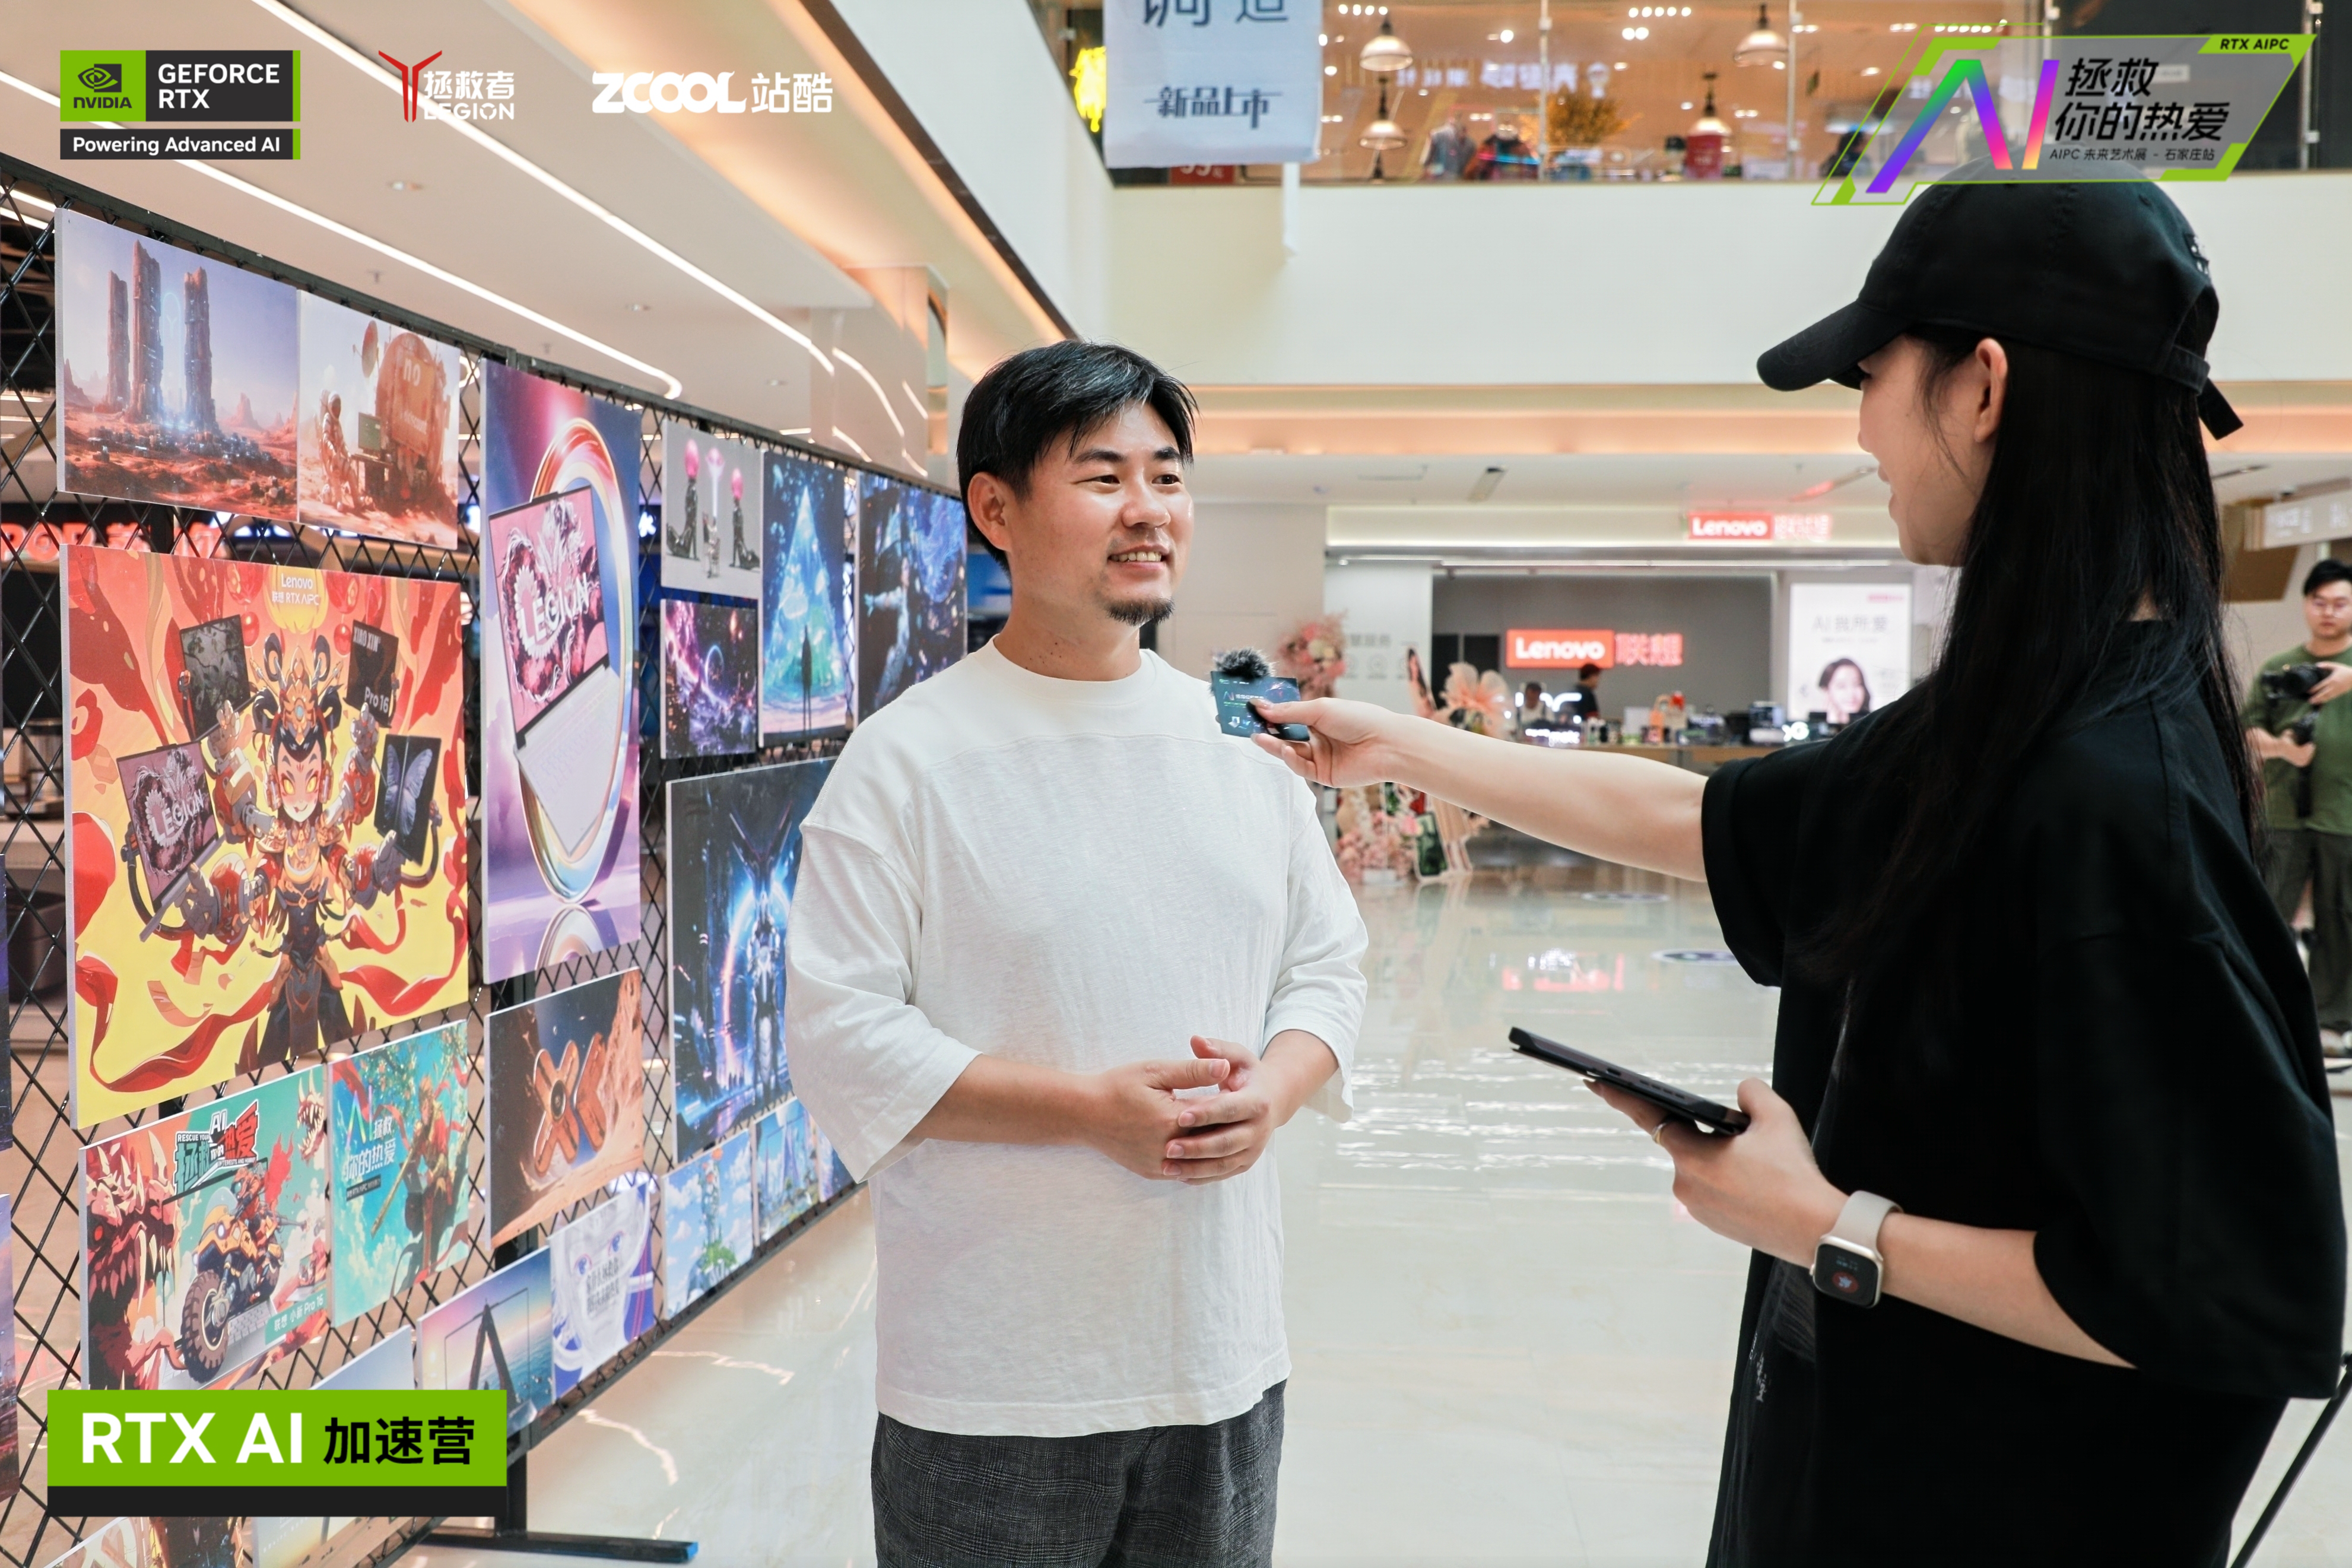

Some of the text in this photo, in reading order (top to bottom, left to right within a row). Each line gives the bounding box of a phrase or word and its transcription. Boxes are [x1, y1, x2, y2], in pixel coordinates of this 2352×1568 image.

[1144, 86, 1283, 129] 新品上市
[1693, 517, 1768, 536] Lenovo
[281, 573, 313, 589] Lenovo
[285, 592, 300, 604] RTX
[301, 593, 319, 605] AIPC
[1515, 636, 1605, 659] Lenovo
[364, 686, 389, 713] Pro 16
[210, 1109, 227, 1135] AI
[177, 1134, 199, 1142] RESCUE
[304, 1301, 315, 1315] Pro
[316, 1294, 323, 1307] 16
